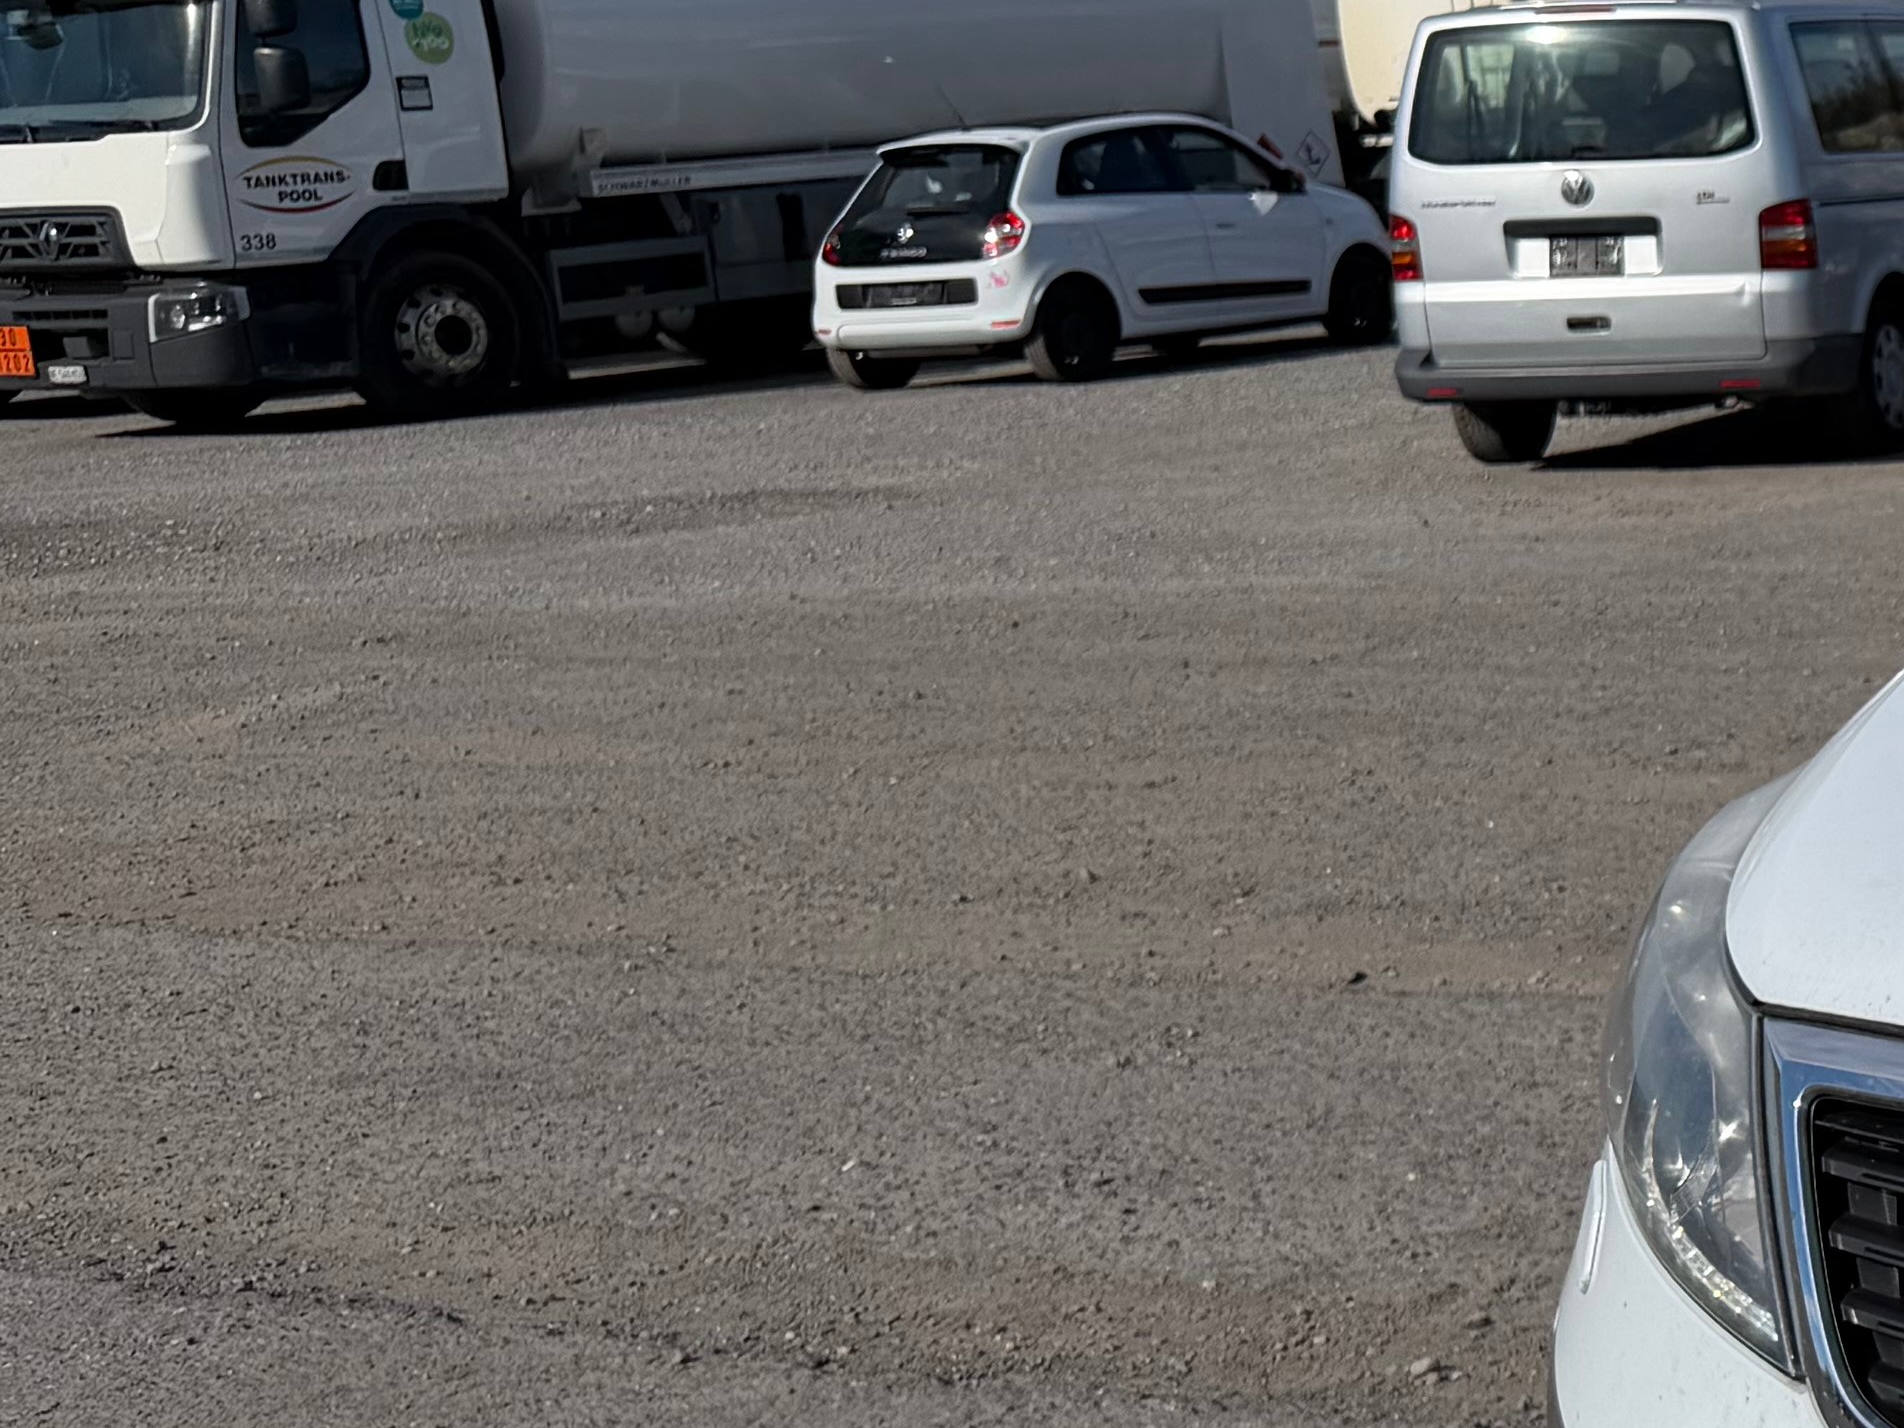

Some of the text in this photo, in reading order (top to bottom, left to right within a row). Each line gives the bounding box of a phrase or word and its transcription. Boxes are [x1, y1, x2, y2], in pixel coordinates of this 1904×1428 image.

[278, 187, 323, 203] POOL
[240, 232, 277, 251] 338
[0, 353, 30, 373] 202
